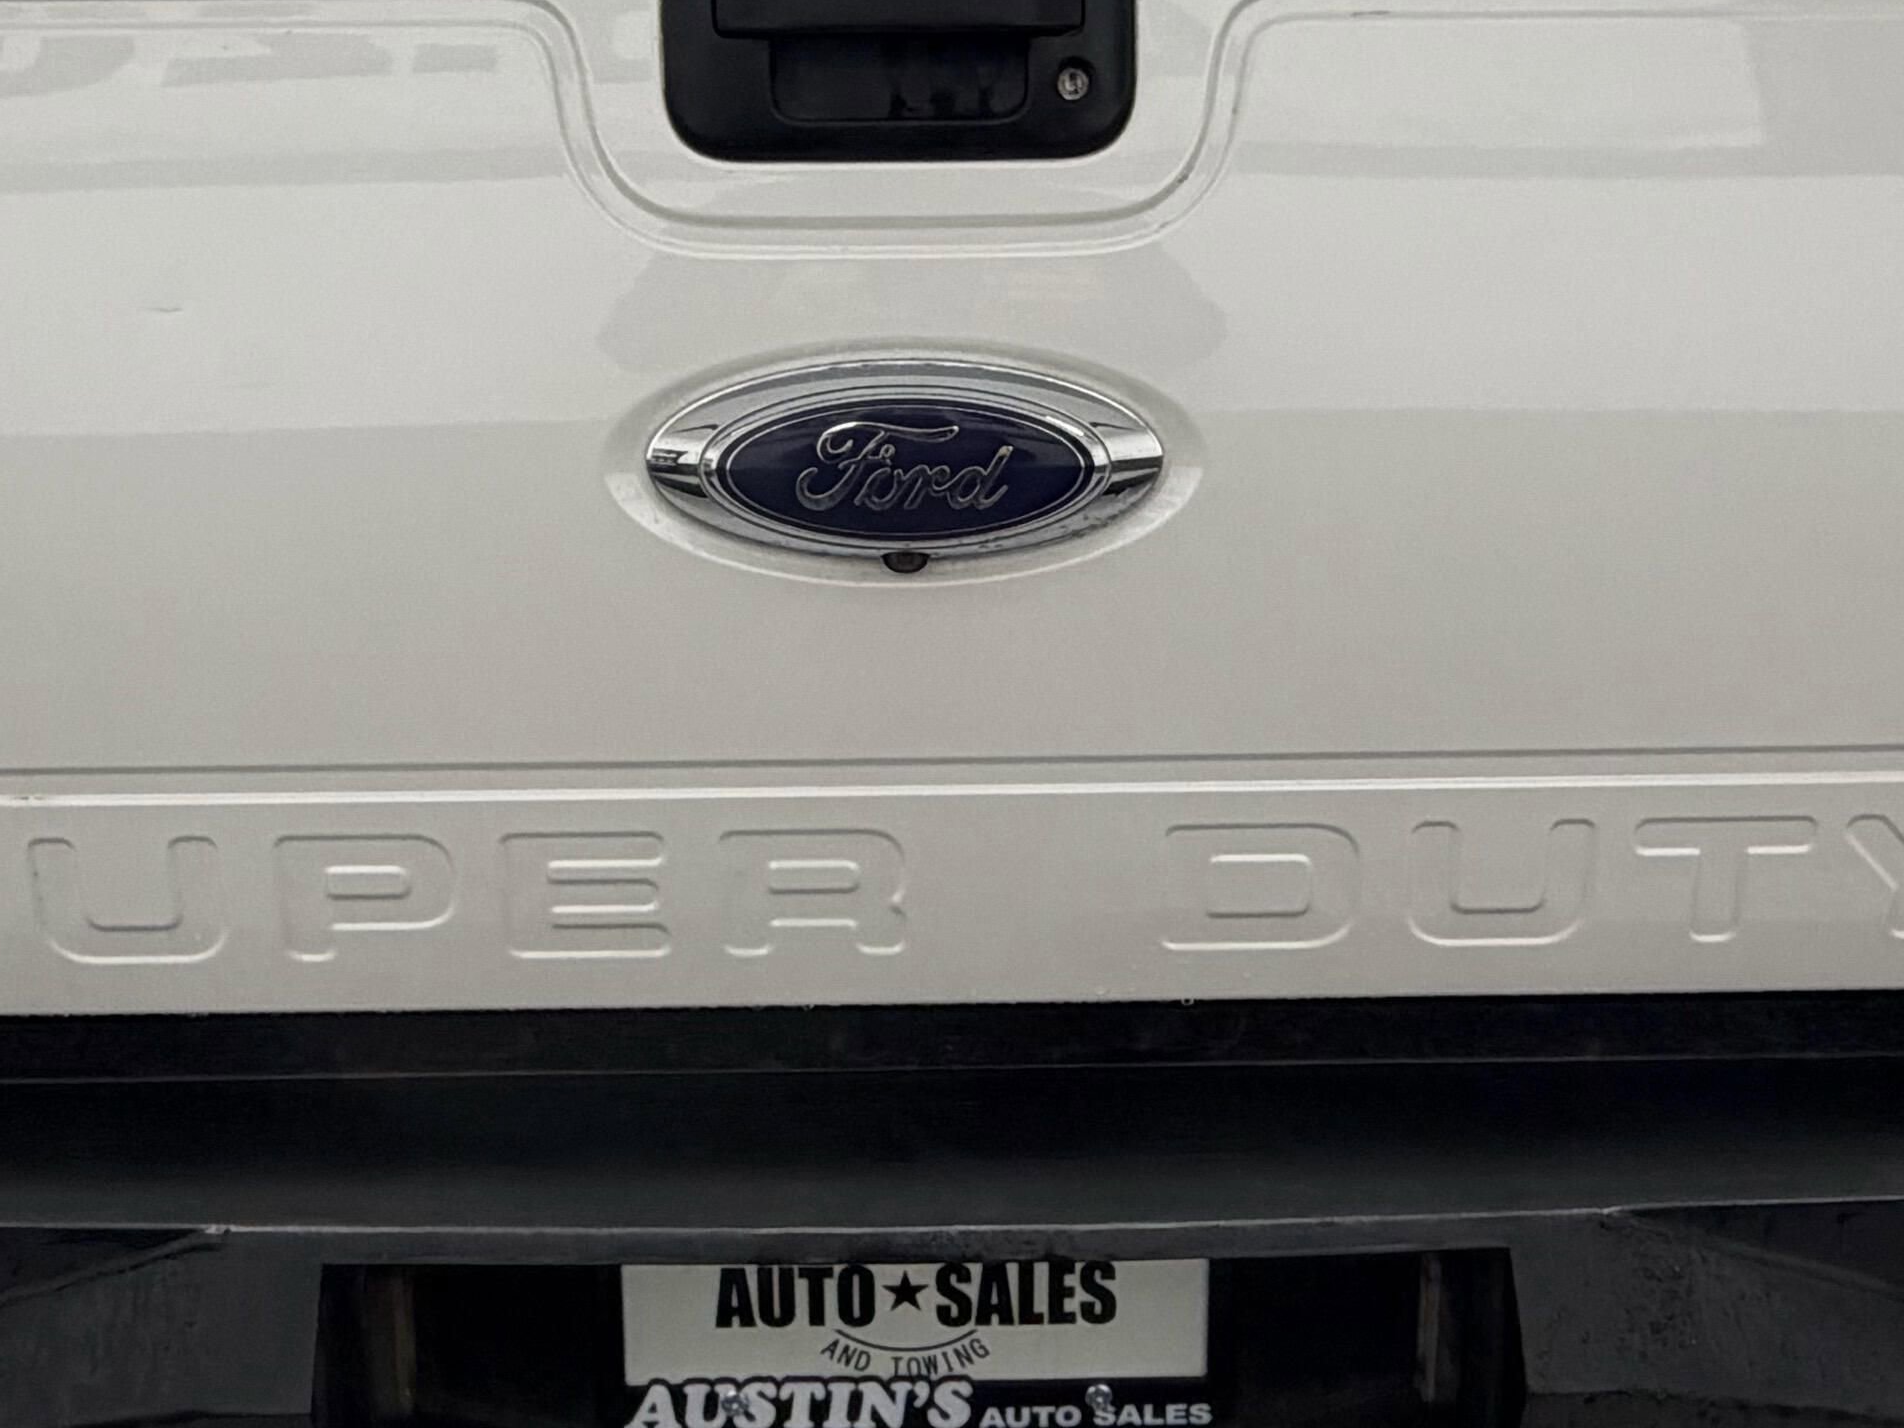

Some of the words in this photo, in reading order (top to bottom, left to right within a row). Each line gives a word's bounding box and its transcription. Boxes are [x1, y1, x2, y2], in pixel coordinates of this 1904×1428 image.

[796, 421, 1014, 512] Ford
[715, 1264, 876, 1329] AUTO
[936, 1261, 1118, 1327] SALES
[820, 1336, 872, 1373] AND
[892, 1336, 991, 1380] TOWING
[1093, 1401, 1213, 1428] SALES
